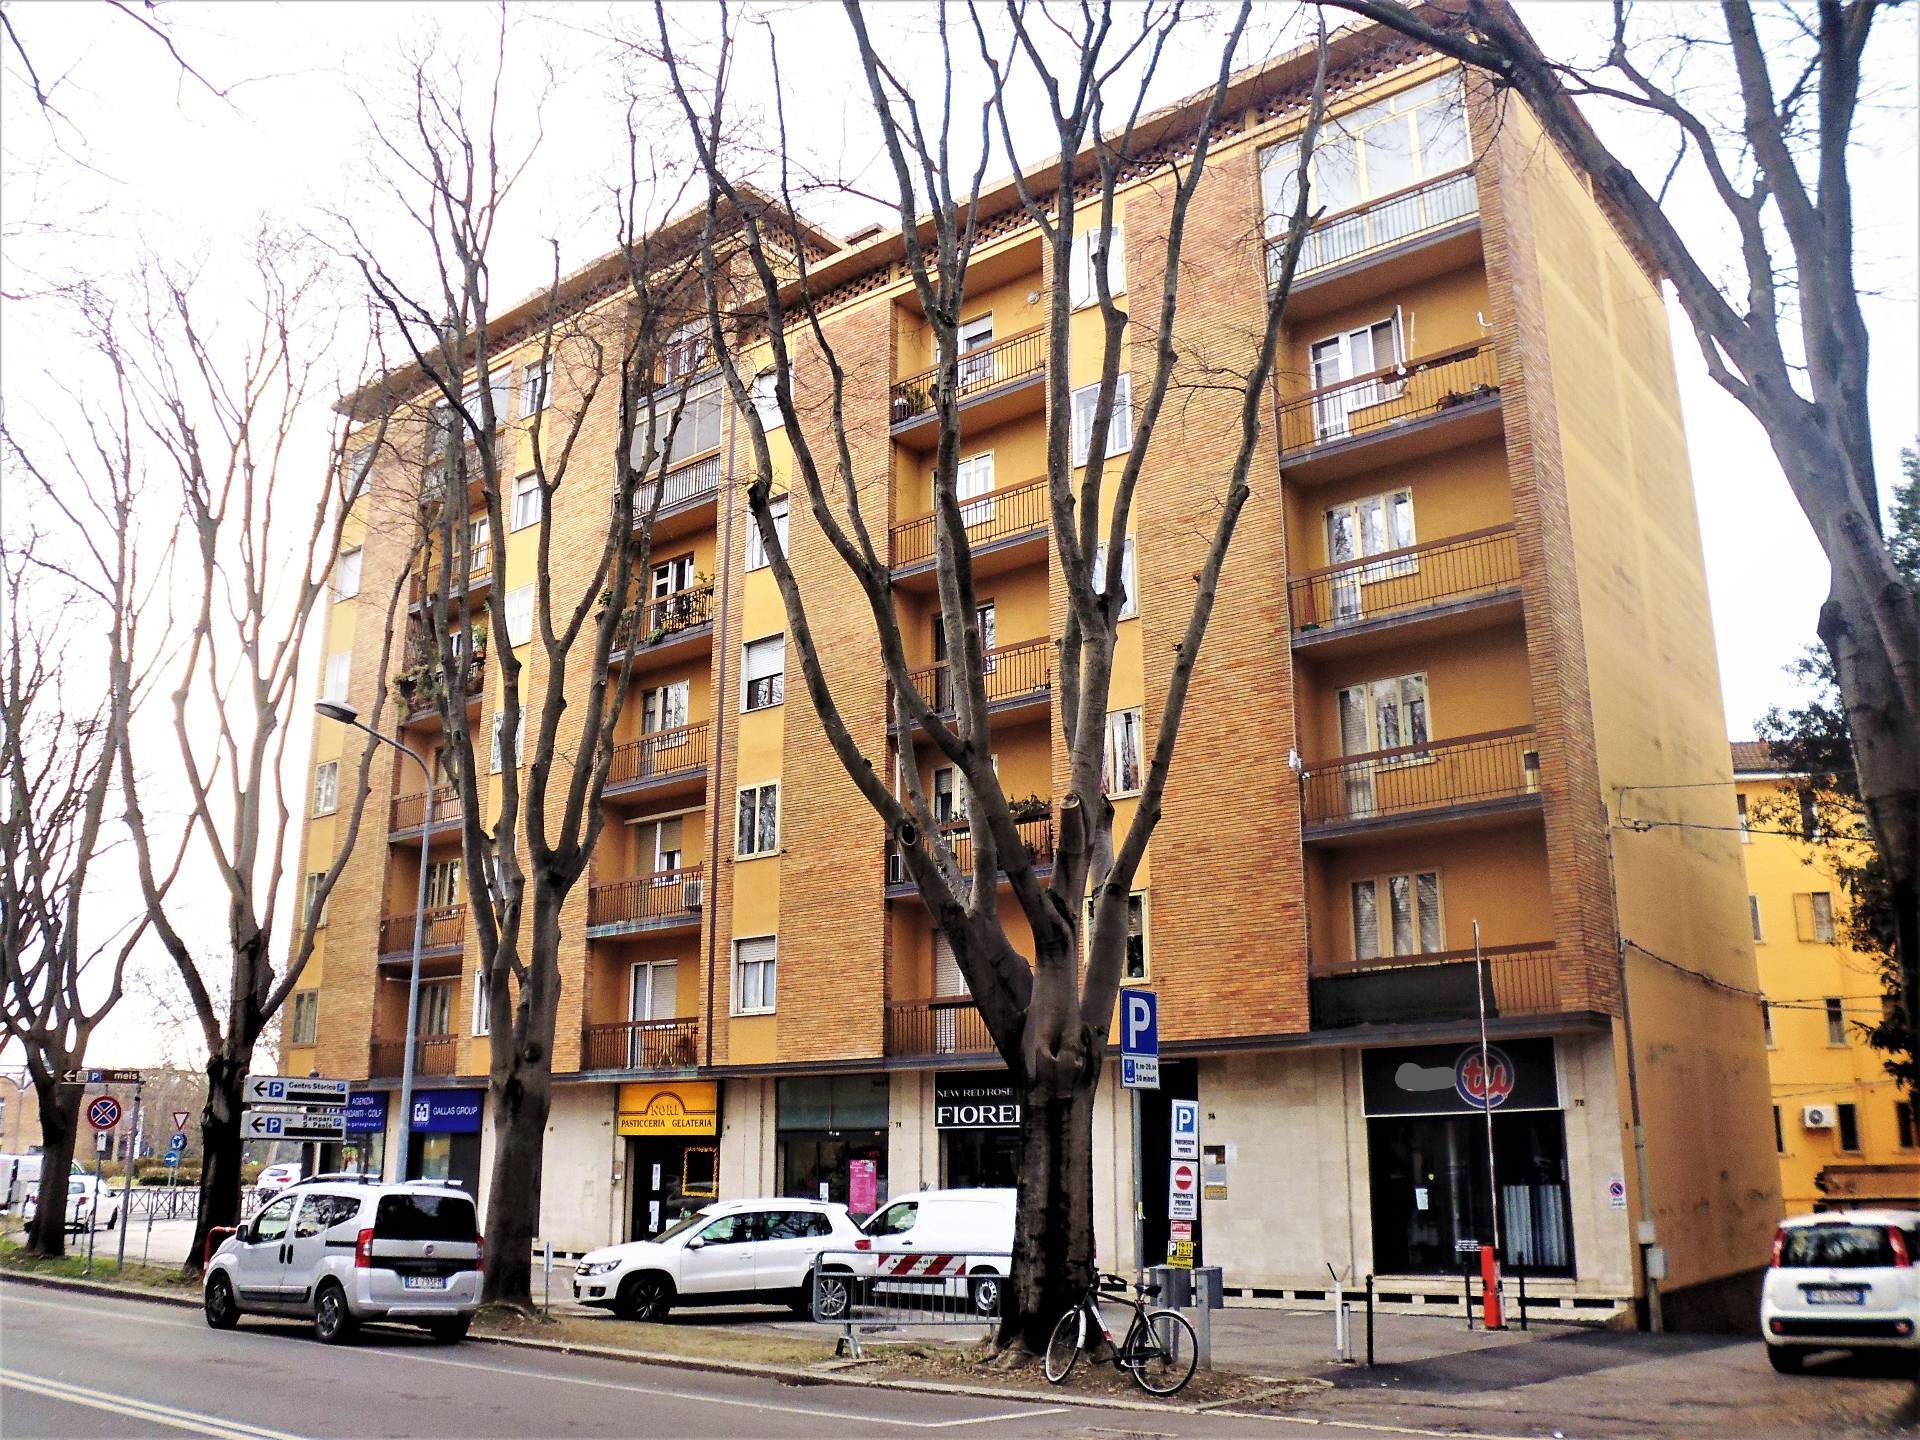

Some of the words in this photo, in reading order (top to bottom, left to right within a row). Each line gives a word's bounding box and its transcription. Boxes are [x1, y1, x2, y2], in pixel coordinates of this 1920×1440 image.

[1129, 997, 1150, 1048] P
[91, 1072, 99, 1081] P
[113, 1072, 138, 1080] meis
[1462, 1055, 1512, 1098] tu
[271, 1083, 280, 1096] P
[288, 1082, 311, 1090] Centro
[312, 1083, 336, 1091] Storico
[937, 1089, 960, 1098] NEW
[963, 1088, 985, 1097] RED
[986, 1087, 1014, 1097] ROSE
[432, 1106, 455, 1115] GALLAS
[456, 1105, 478, 1115] GROUP
[937, 1104, 1020, 1124] FIORE
[268, 1119, 279, 1132] P
[621, 1119, 666, 1128] PASTICCERIA
[671, 1119, 713, 1128] GELATERIA
[1178, 1108, 1191, 1131] P
